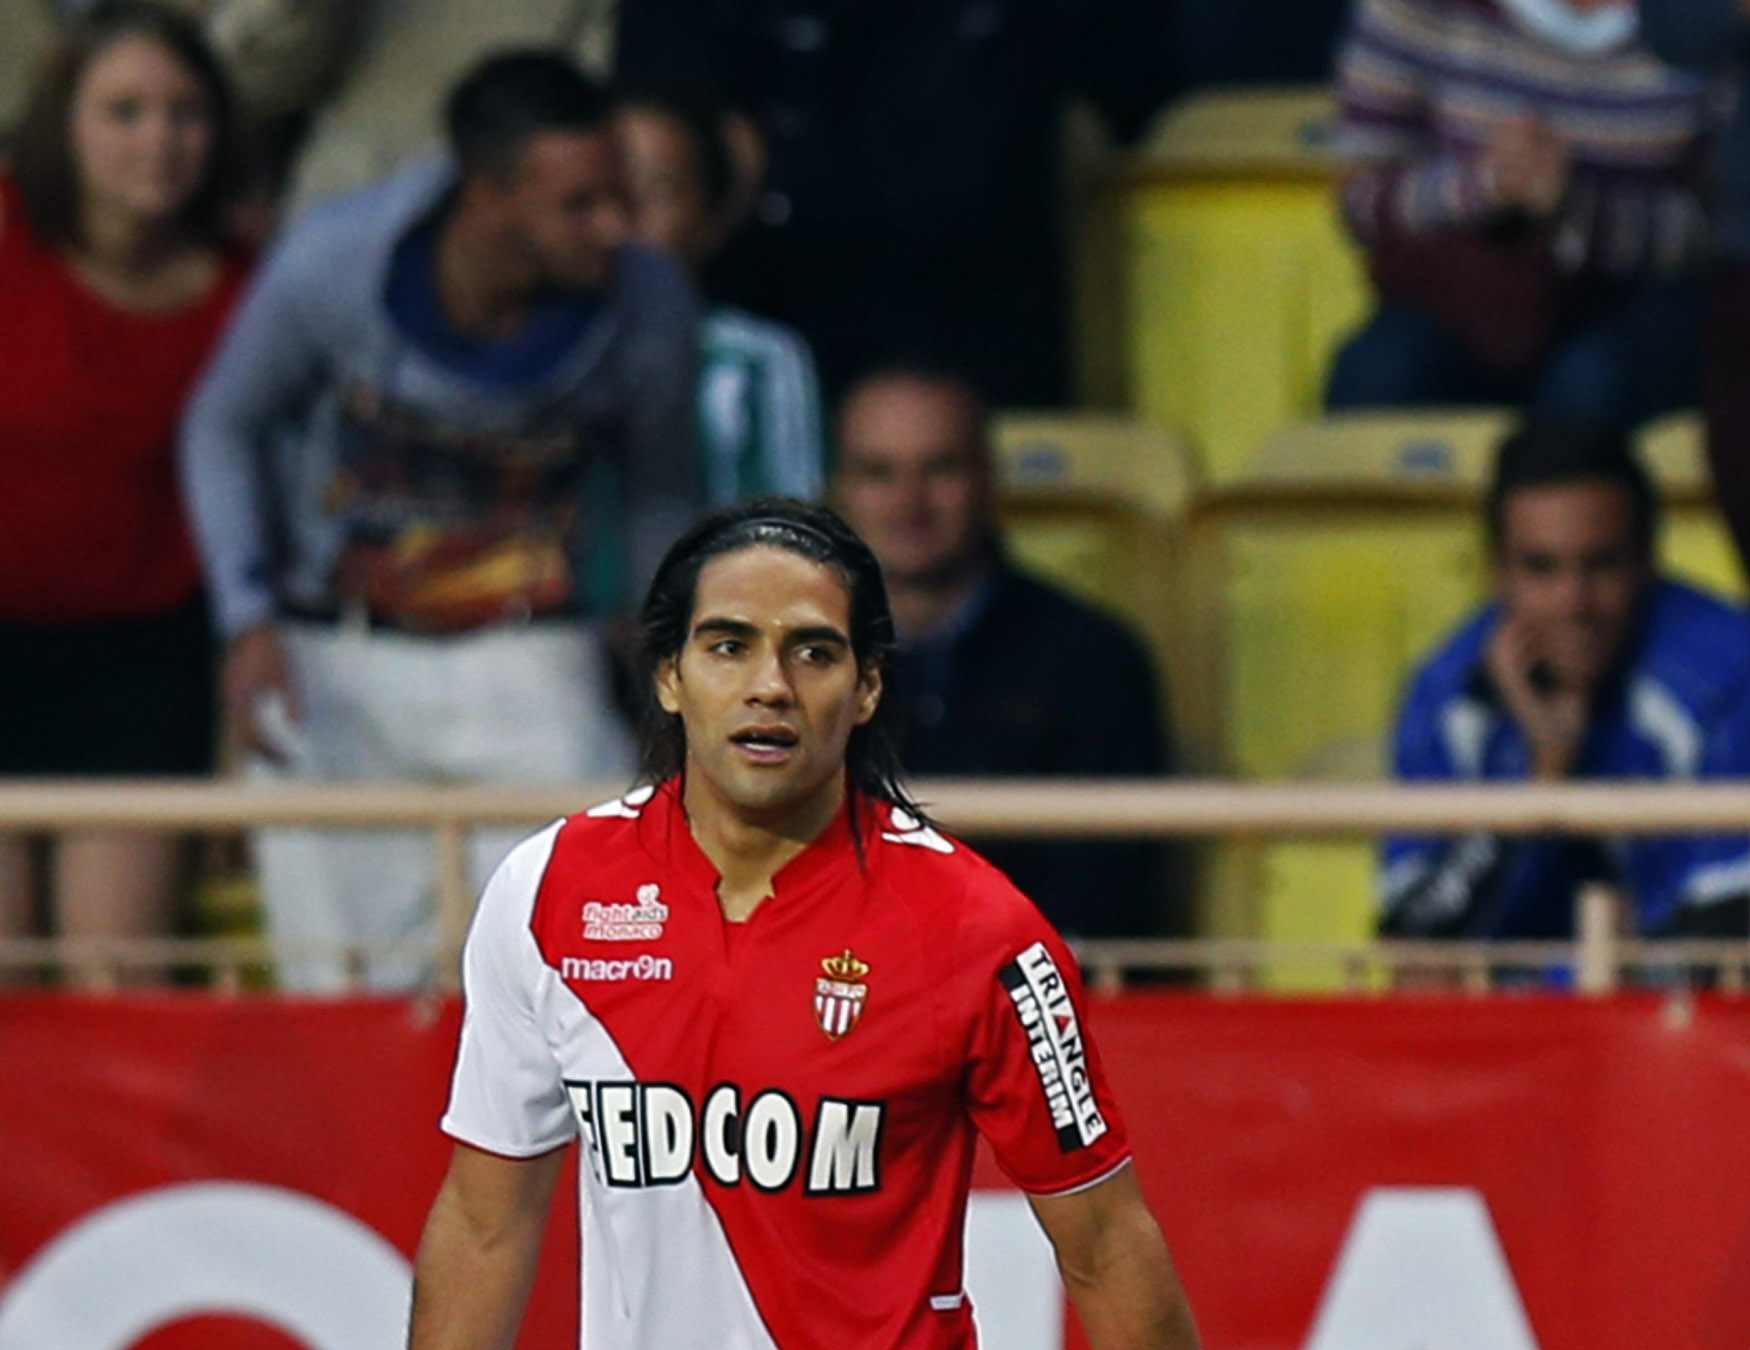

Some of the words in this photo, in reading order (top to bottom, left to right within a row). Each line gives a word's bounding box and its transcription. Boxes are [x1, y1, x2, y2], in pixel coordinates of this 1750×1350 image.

[561, 954, 673, 981] macron
[1008, 982, 1077, 1131] INTERIM
[1030, 950, 1103, 1137] TRIANGLE
